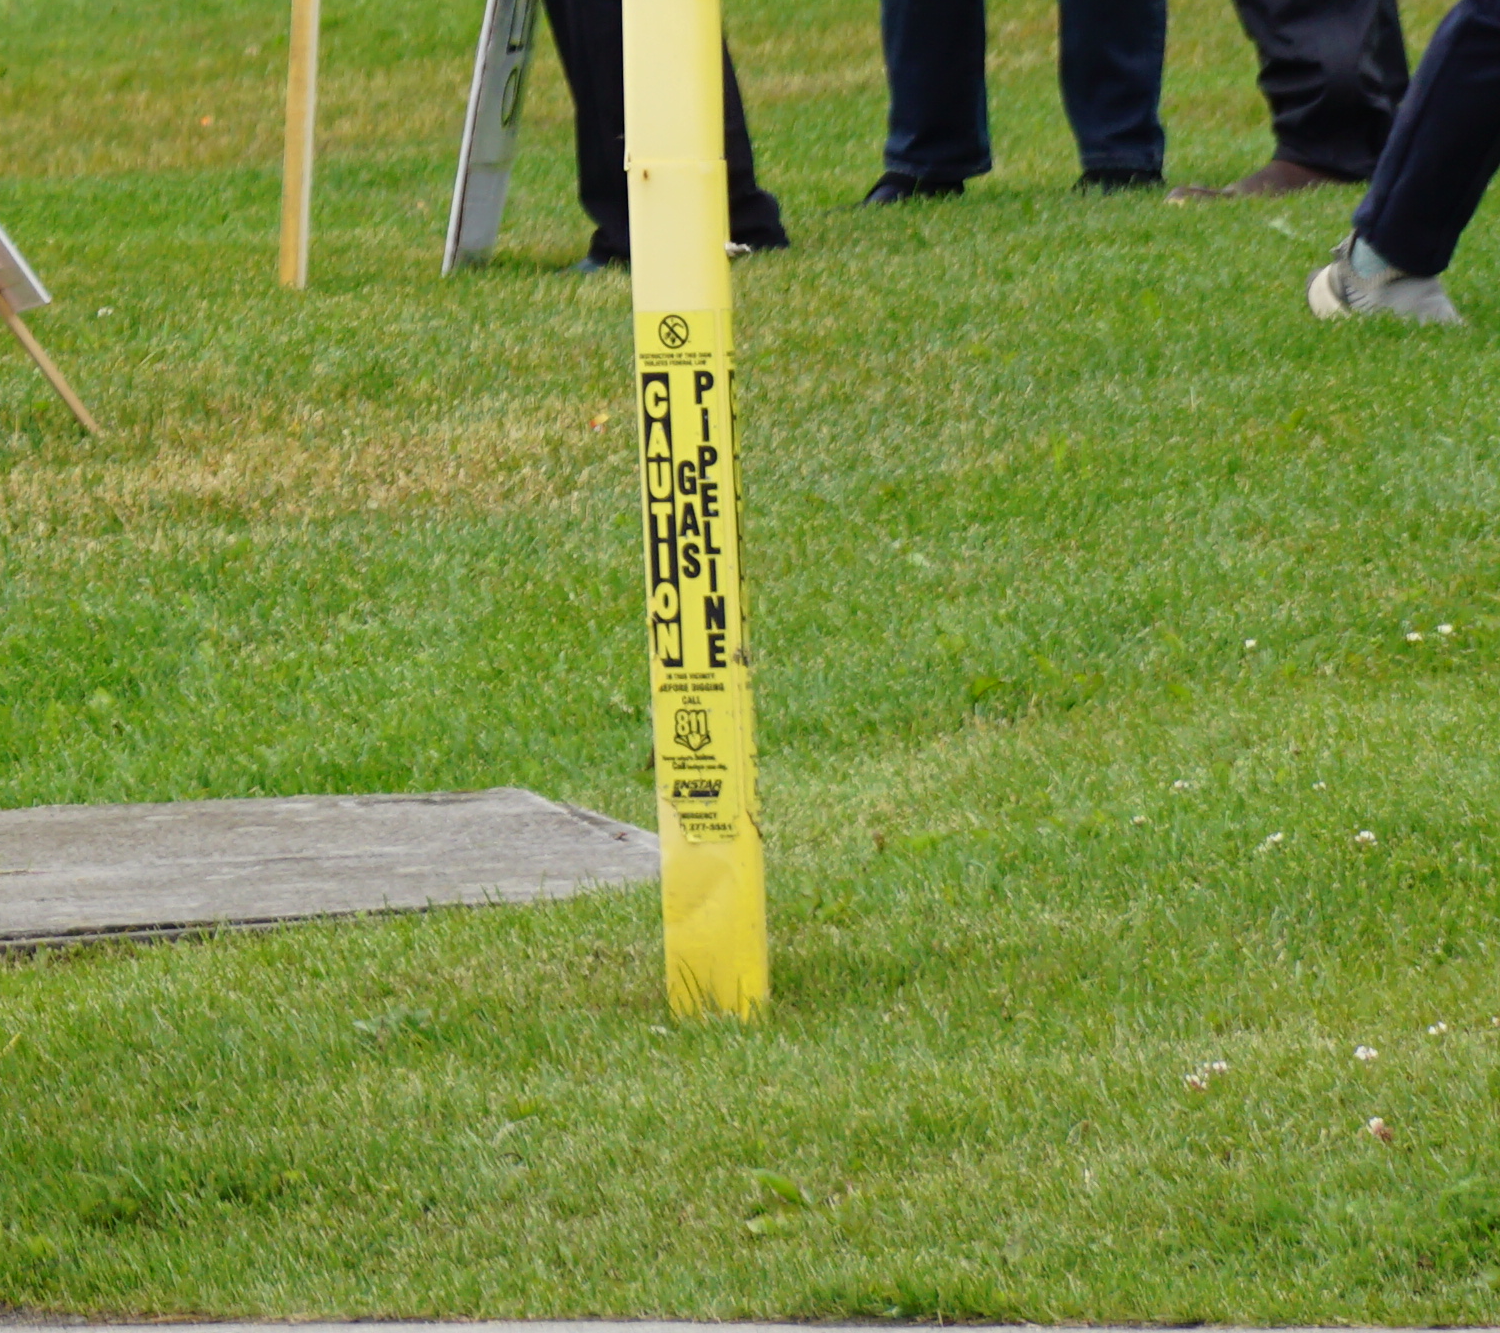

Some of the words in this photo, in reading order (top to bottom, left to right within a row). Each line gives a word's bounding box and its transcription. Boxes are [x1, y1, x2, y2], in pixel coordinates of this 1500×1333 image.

[644, 379, 681, 661] CAUTION
[678, 460, 701, 578] GAS
[694, 370, 727, 668] PIPELINE
[674, 708, 708, 737] 811
[682, 695, 702, 705] CALL
[673, 778, 723, 790] ENSTAR
